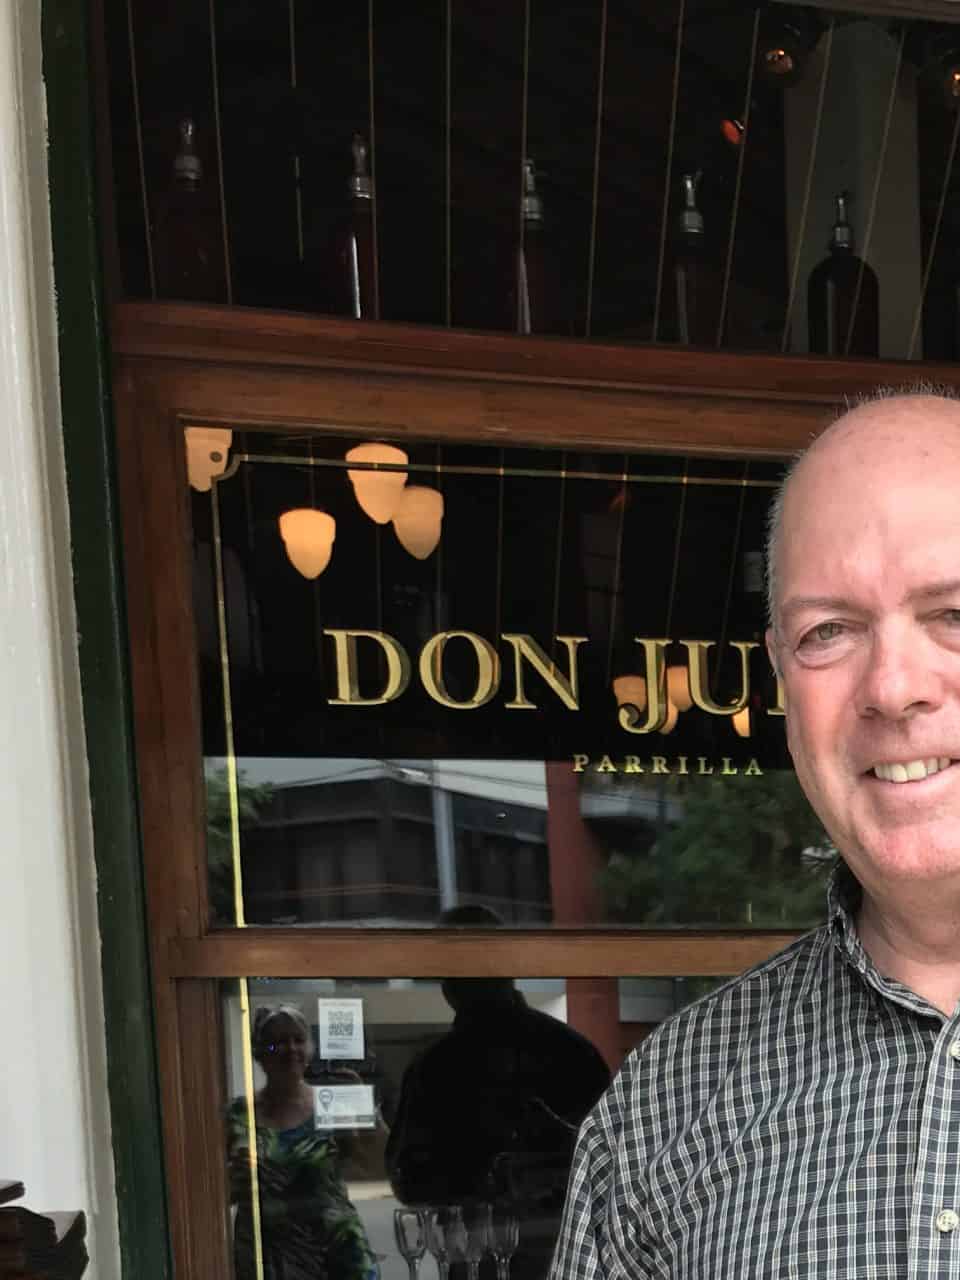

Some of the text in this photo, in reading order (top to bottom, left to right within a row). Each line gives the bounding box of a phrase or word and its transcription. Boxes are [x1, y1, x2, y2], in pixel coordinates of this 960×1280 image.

[323, 629, 786, 733] DON JU
[572, 754, 764, 776] PARRILLA
